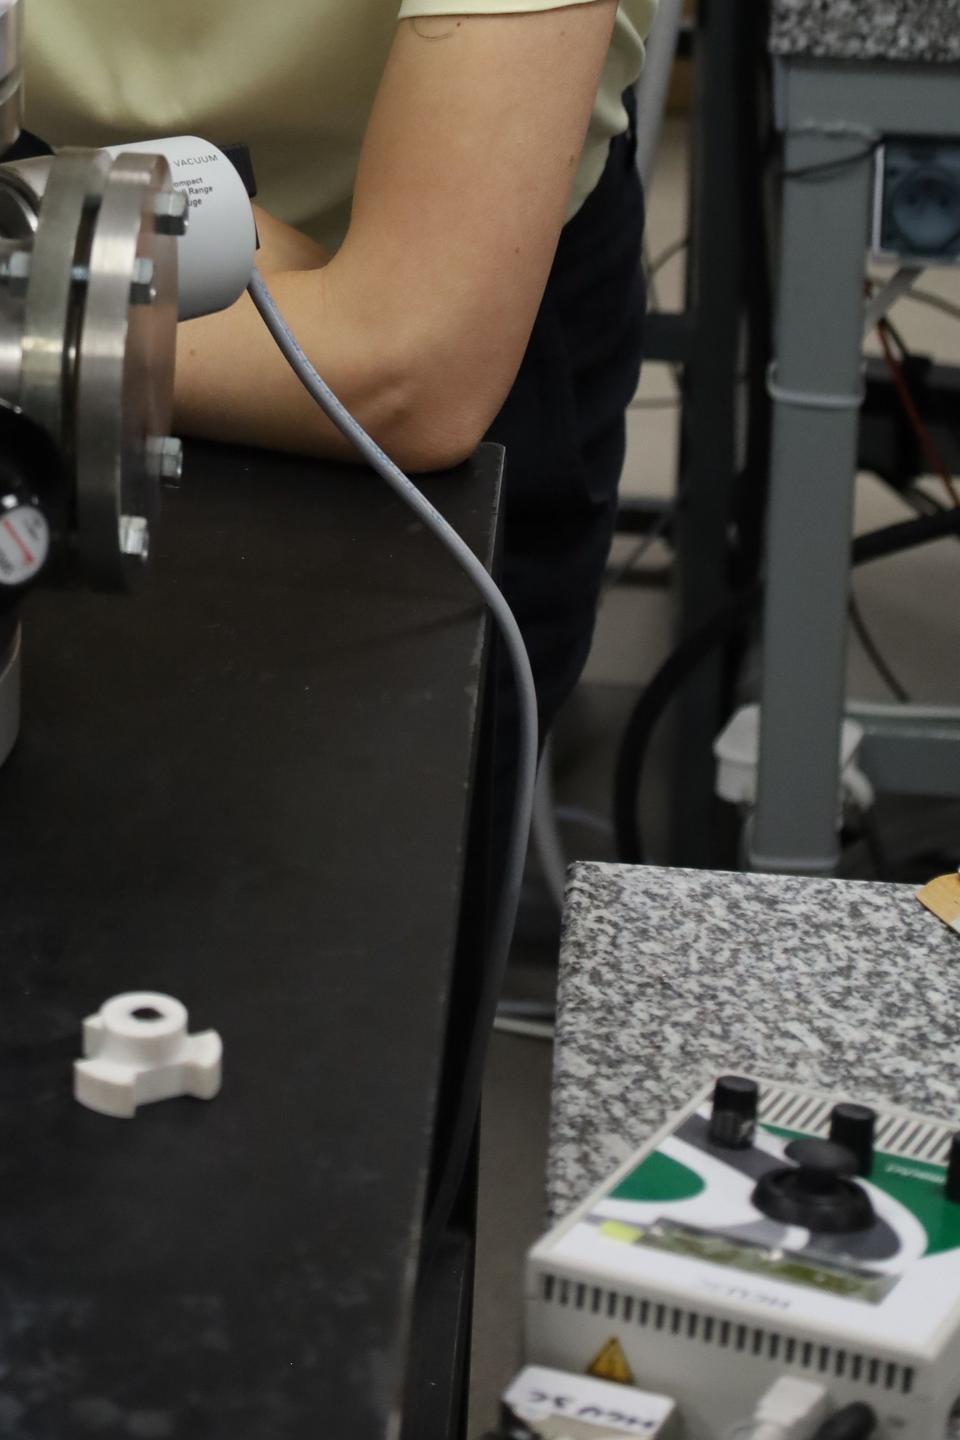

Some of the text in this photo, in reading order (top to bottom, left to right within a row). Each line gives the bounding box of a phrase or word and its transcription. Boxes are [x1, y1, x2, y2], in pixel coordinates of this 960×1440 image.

[174, 155, 218, 167] VACUUM
[173, 177, 203, 188] ompact
[189, 186, 213, 195] Range
